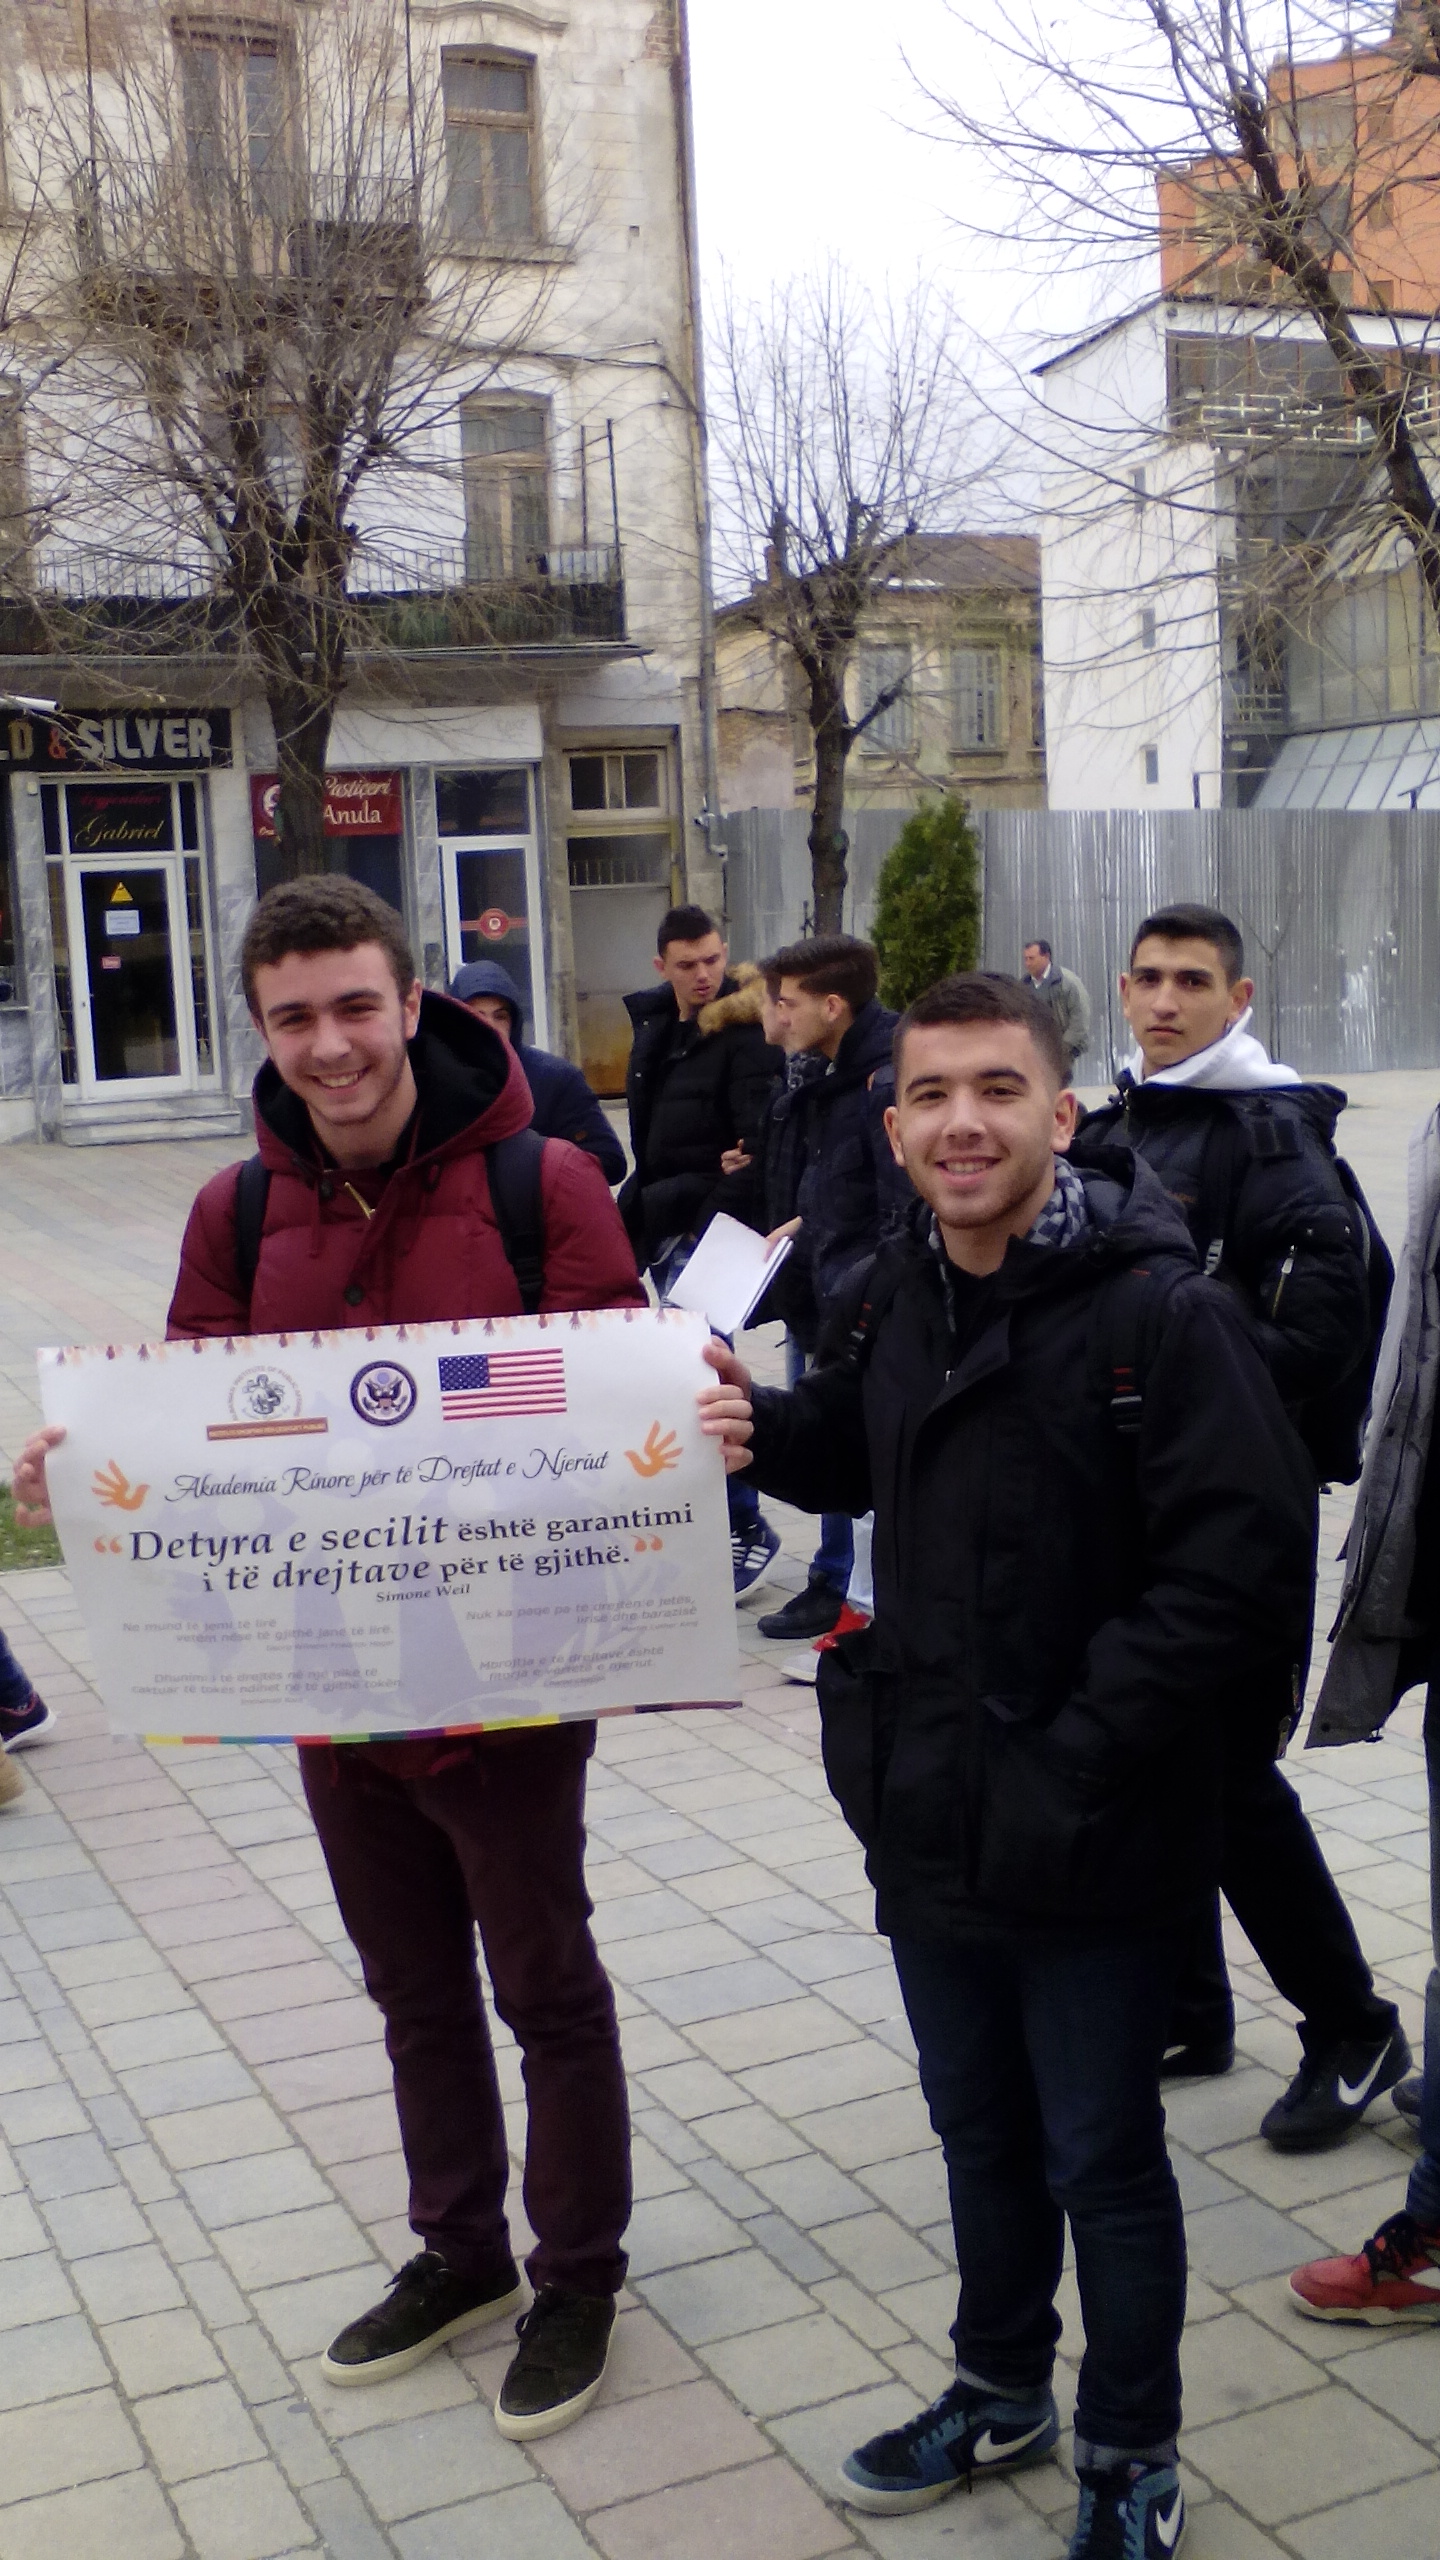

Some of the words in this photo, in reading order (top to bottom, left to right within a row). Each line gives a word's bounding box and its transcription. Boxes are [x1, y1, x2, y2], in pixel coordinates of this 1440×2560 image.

[77, 717, 213, 760] SILVER
[75, 814, 165, 848] Gabriel
[323, 800, 382, 825] Anula
[164, 1473, 278, 1502] Akademia
[282, 1466, 355, 1496] Rinore
[350, 1467, 391, 1498] për
[396, 1465, 413, 1485] të
[417, 1455, 502, 1487] Drejtat
[506, 1461, 517, 1476] e
[129, 1530, 274, 1567] Detyra
[289, 1530, 307, 1552] e
[321, 1514, 449, 1551] secilit
[458, 1518, 536, 1542] është
[547, 1502, 695, 1542] garantimi
[202, 1571, 214, 1592] i
[225, 1565, 260, 1591] të
[273, 1558, 431, 1594] drejtave
[440, 1557, 489, 1583] për
[498, 1552, 525, 1573] të
[534, 1544, 630, 1577] gjithë.
[376, 1589, 431, 1603] Simone
[436, 1583, 471, 1597] Weil
